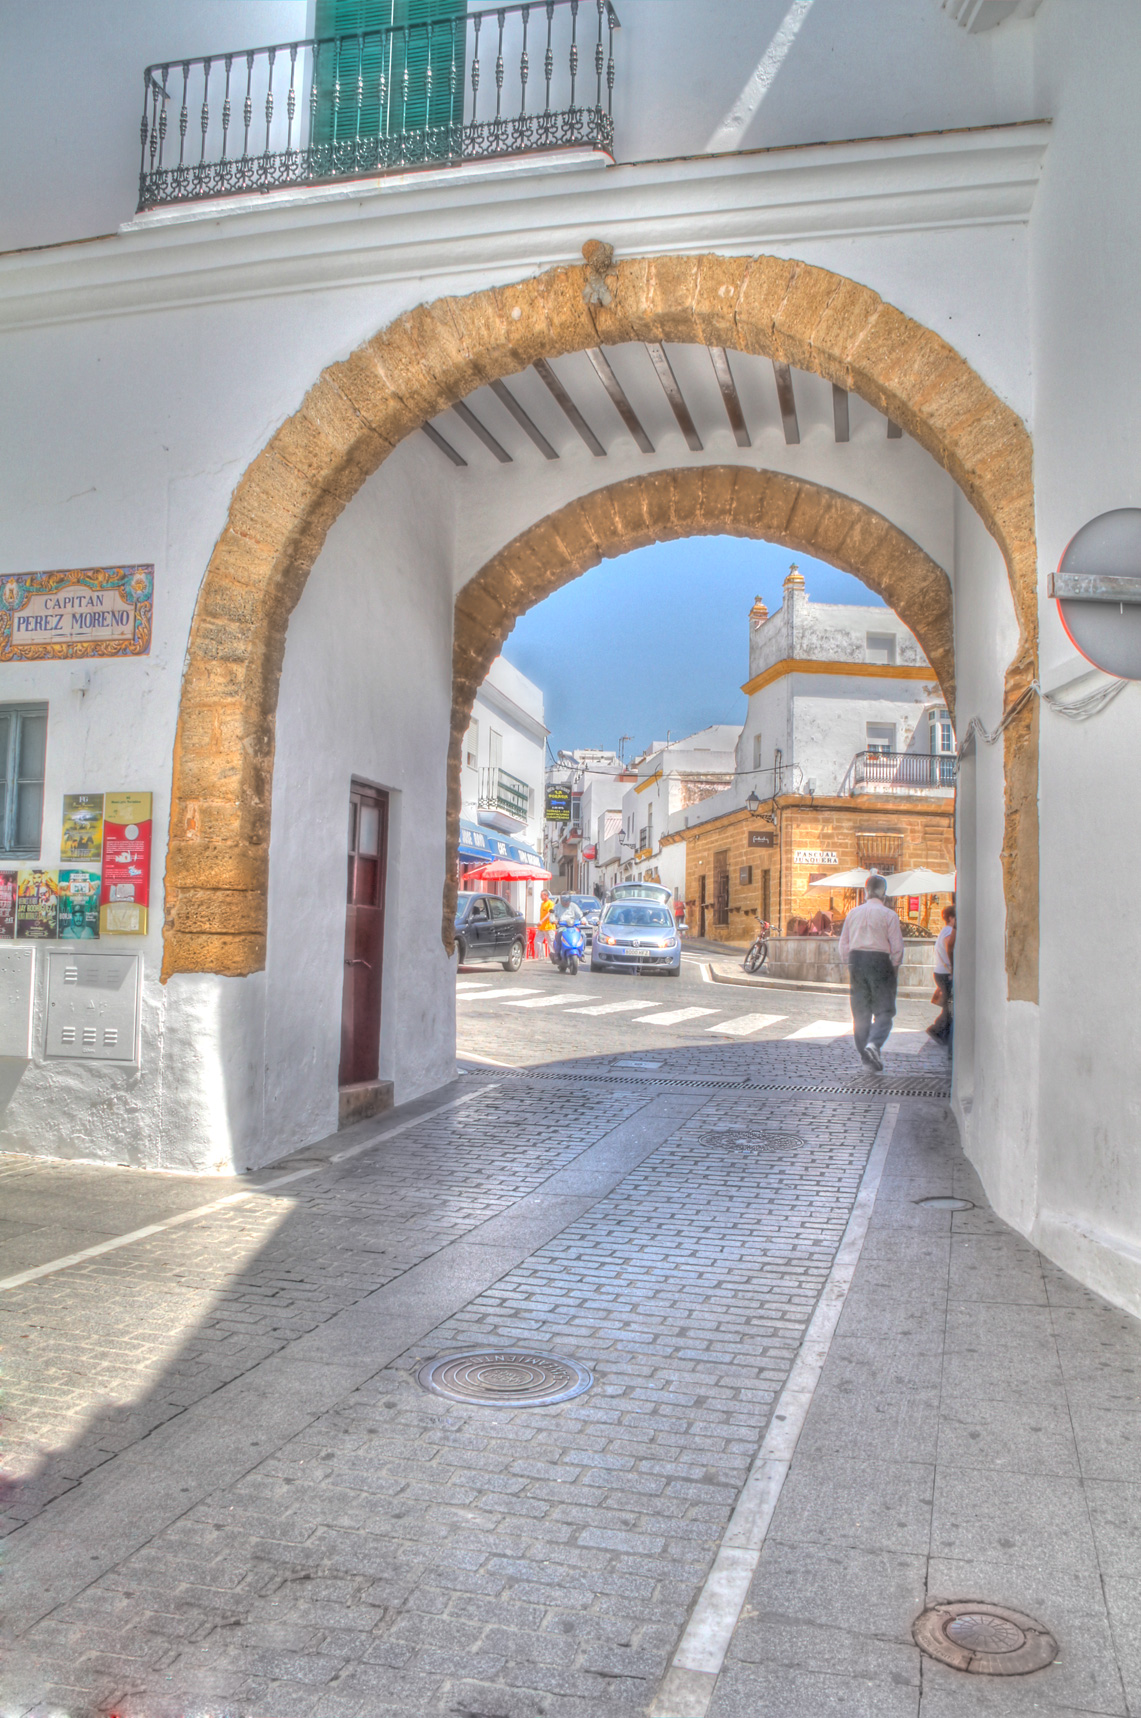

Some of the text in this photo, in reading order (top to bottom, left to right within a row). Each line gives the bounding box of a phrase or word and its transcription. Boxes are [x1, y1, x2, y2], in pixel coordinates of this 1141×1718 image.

[44, 594, 104, 610] CAPITAN
[16, 610, 130, 632] PEREZ MORENO
